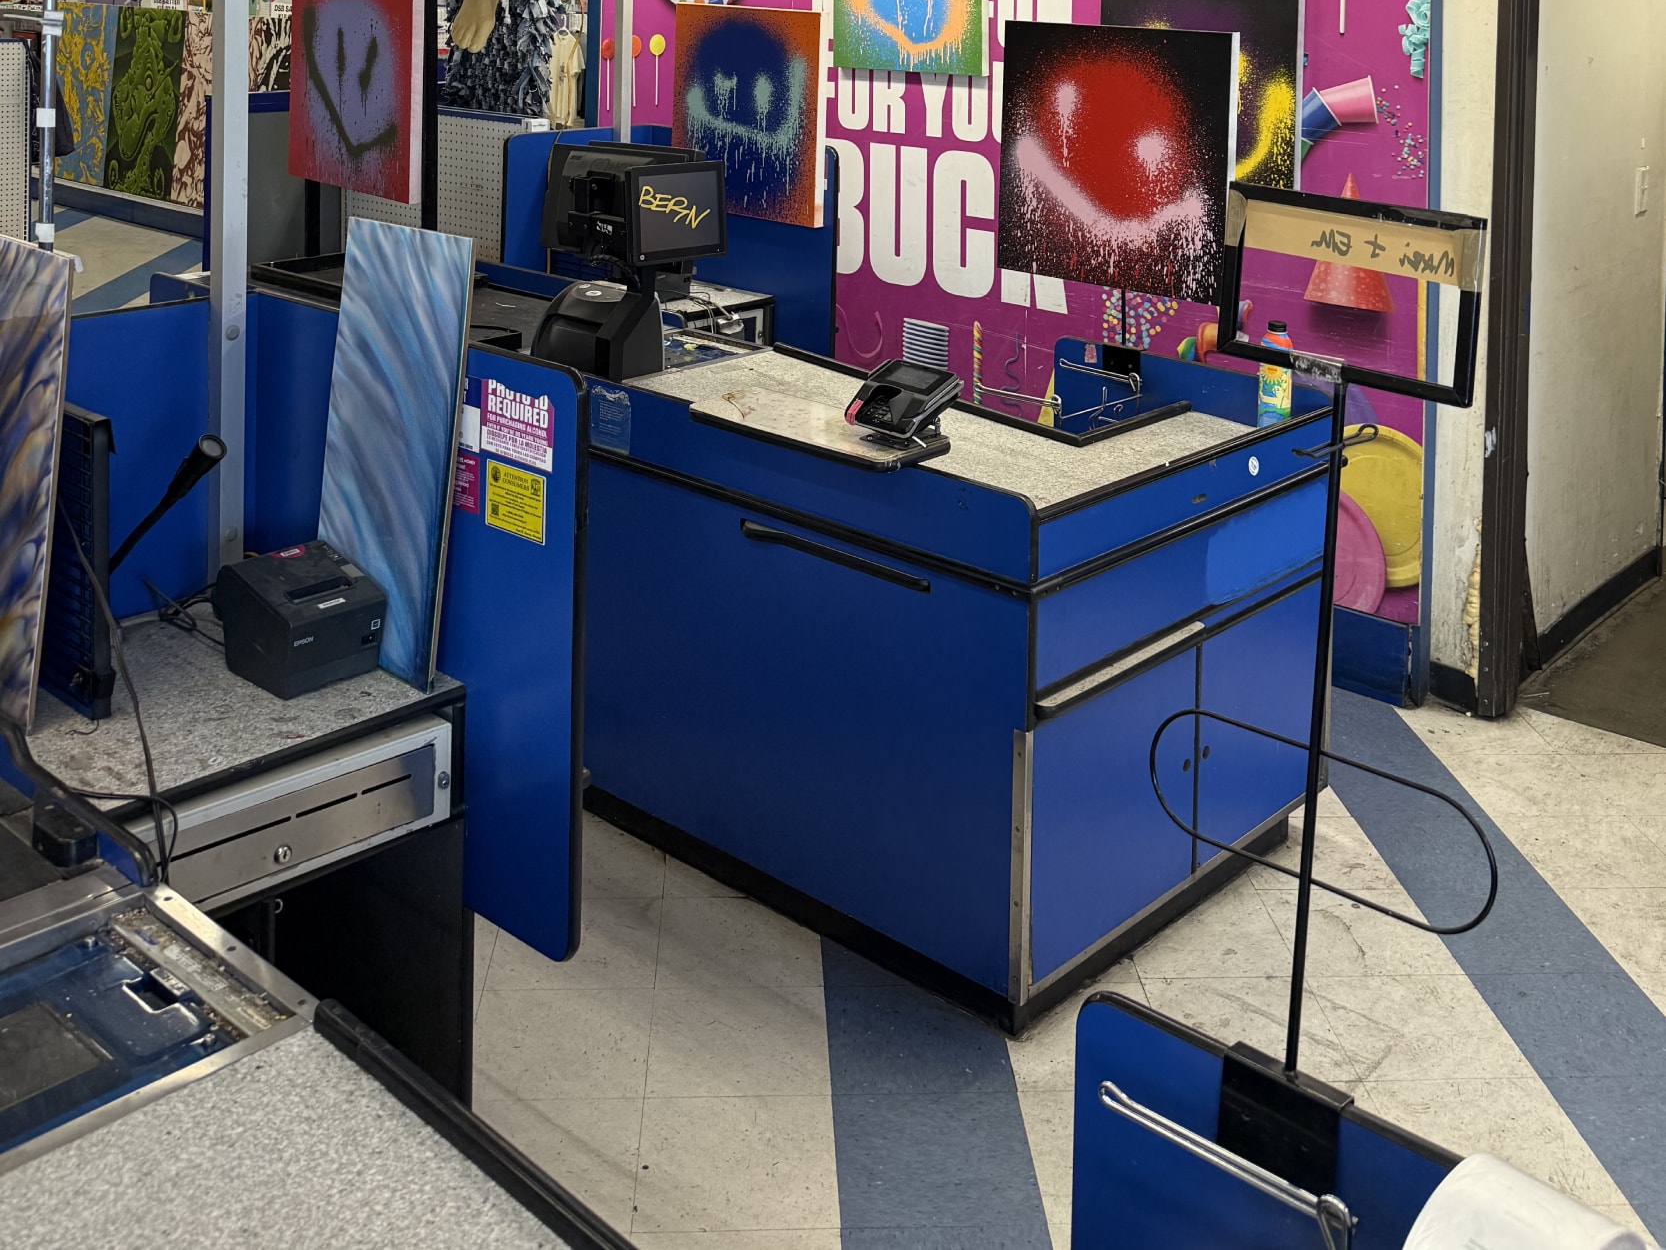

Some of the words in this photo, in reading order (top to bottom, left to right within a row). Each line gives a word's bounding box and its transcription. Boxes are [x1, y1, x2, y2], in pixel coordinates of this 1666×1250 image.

[826, 50, 906, 135] OR
[638, 185, 711, 229] BERN
[824, 137, 1069, 315] BUC
[488, 394, 548, 428] REQUIRED
[294, 636, 314, 647] EPSON
